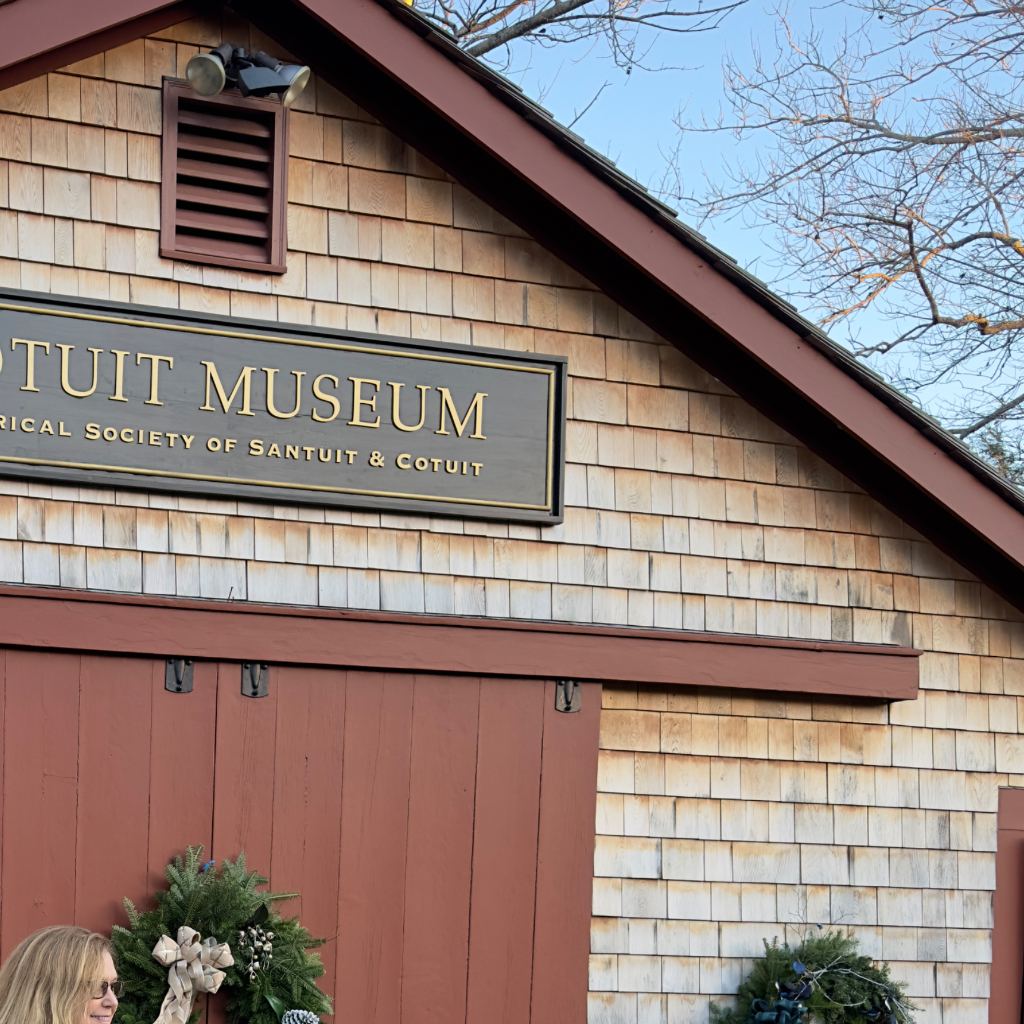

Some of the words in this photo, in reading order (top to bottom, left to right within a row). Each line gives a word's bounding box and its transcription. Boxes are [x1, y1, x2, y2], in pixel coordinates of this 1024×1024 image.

[199, 360, 489, 440] MUSEUM
[84, 422, 195, 450] SOCIETY
[207, 436, 238, 453] OF
[248, 438, 358, 465] SANTUIT
[369, 450, 385, 468] &
[396, 453, 484, 477] COTUIT
